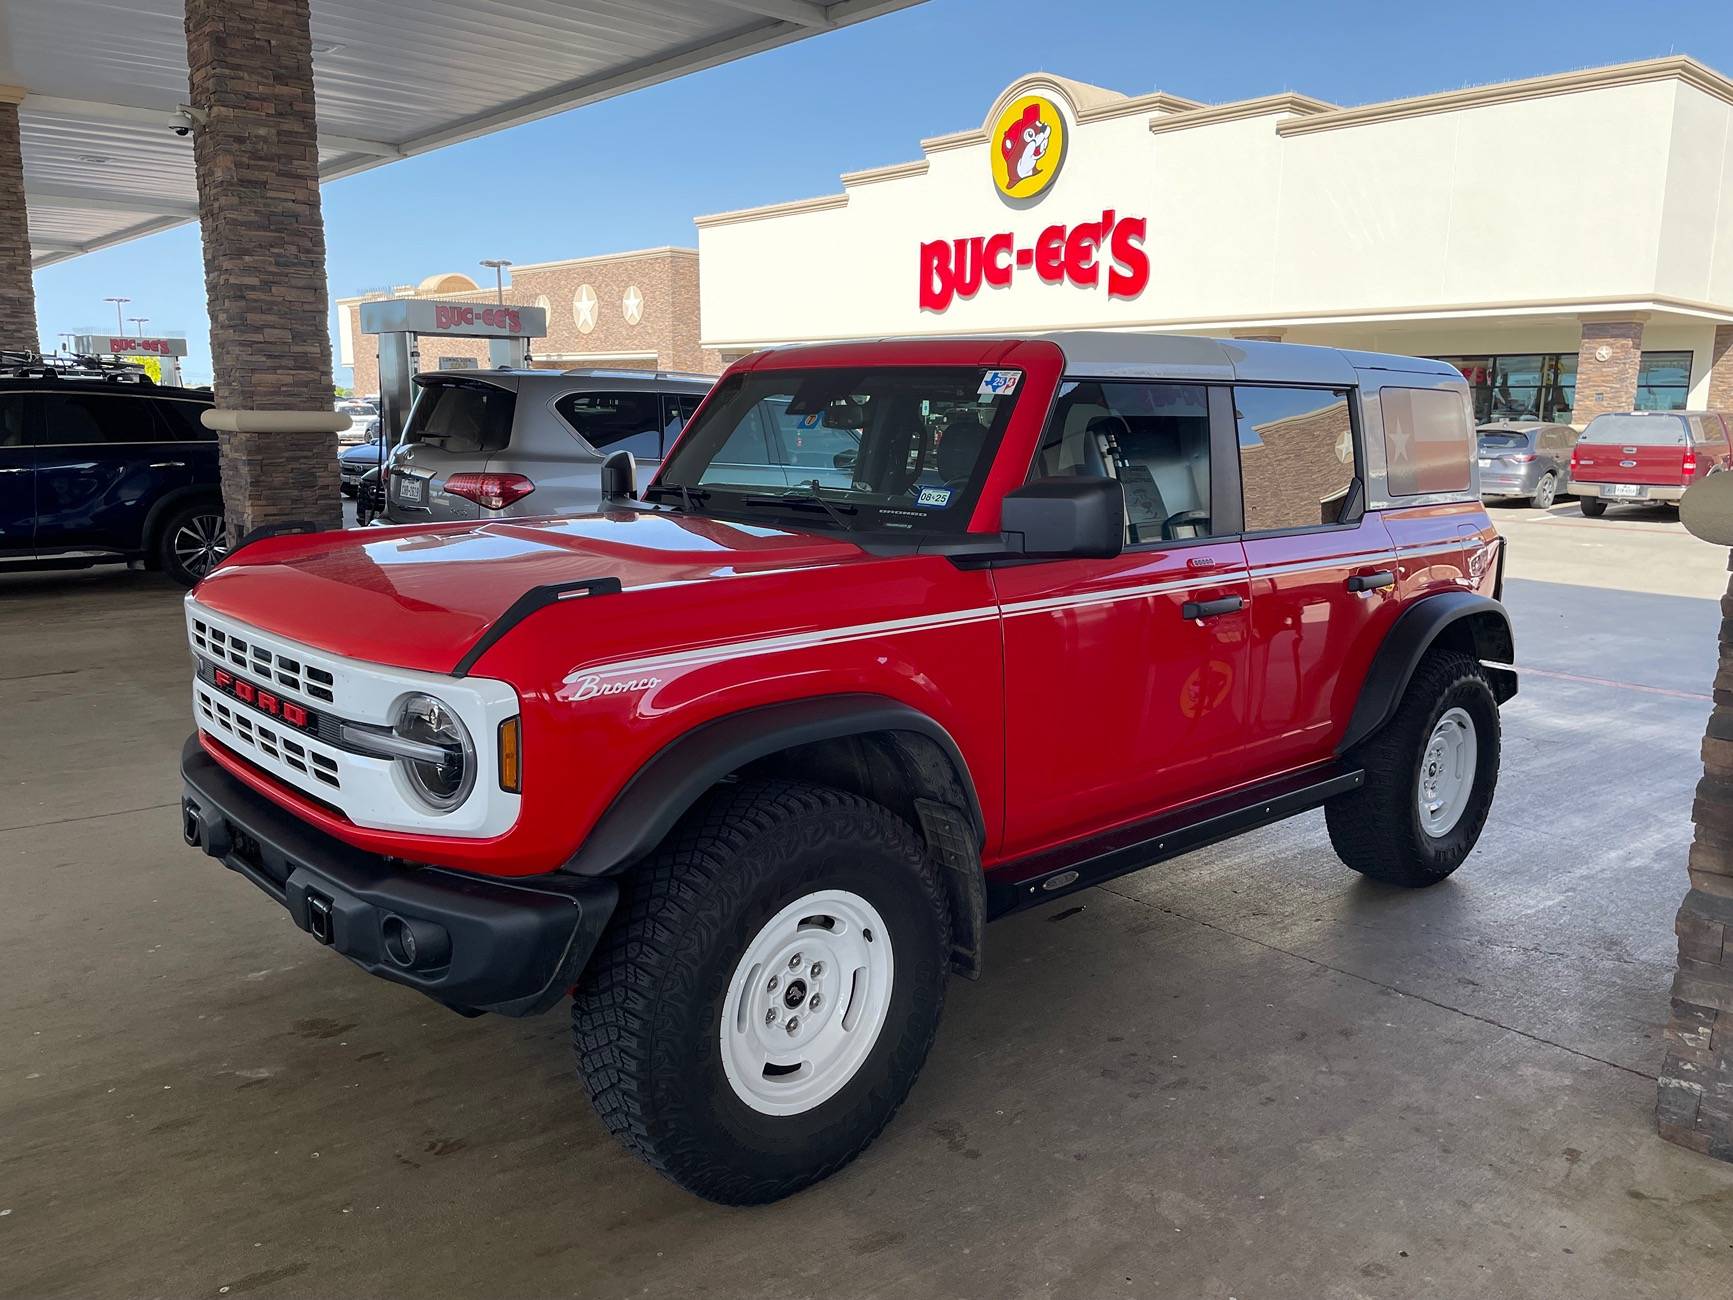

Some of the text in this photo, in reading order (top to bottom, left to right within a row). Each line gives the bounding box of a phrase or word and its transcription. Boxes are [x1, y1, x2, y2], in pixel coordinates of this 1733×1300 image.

[919, 209, 1150, 313] BUC-EE'S
[215, 669, 308, 727] FORD
[569, 675, 662, 702] Bronco
